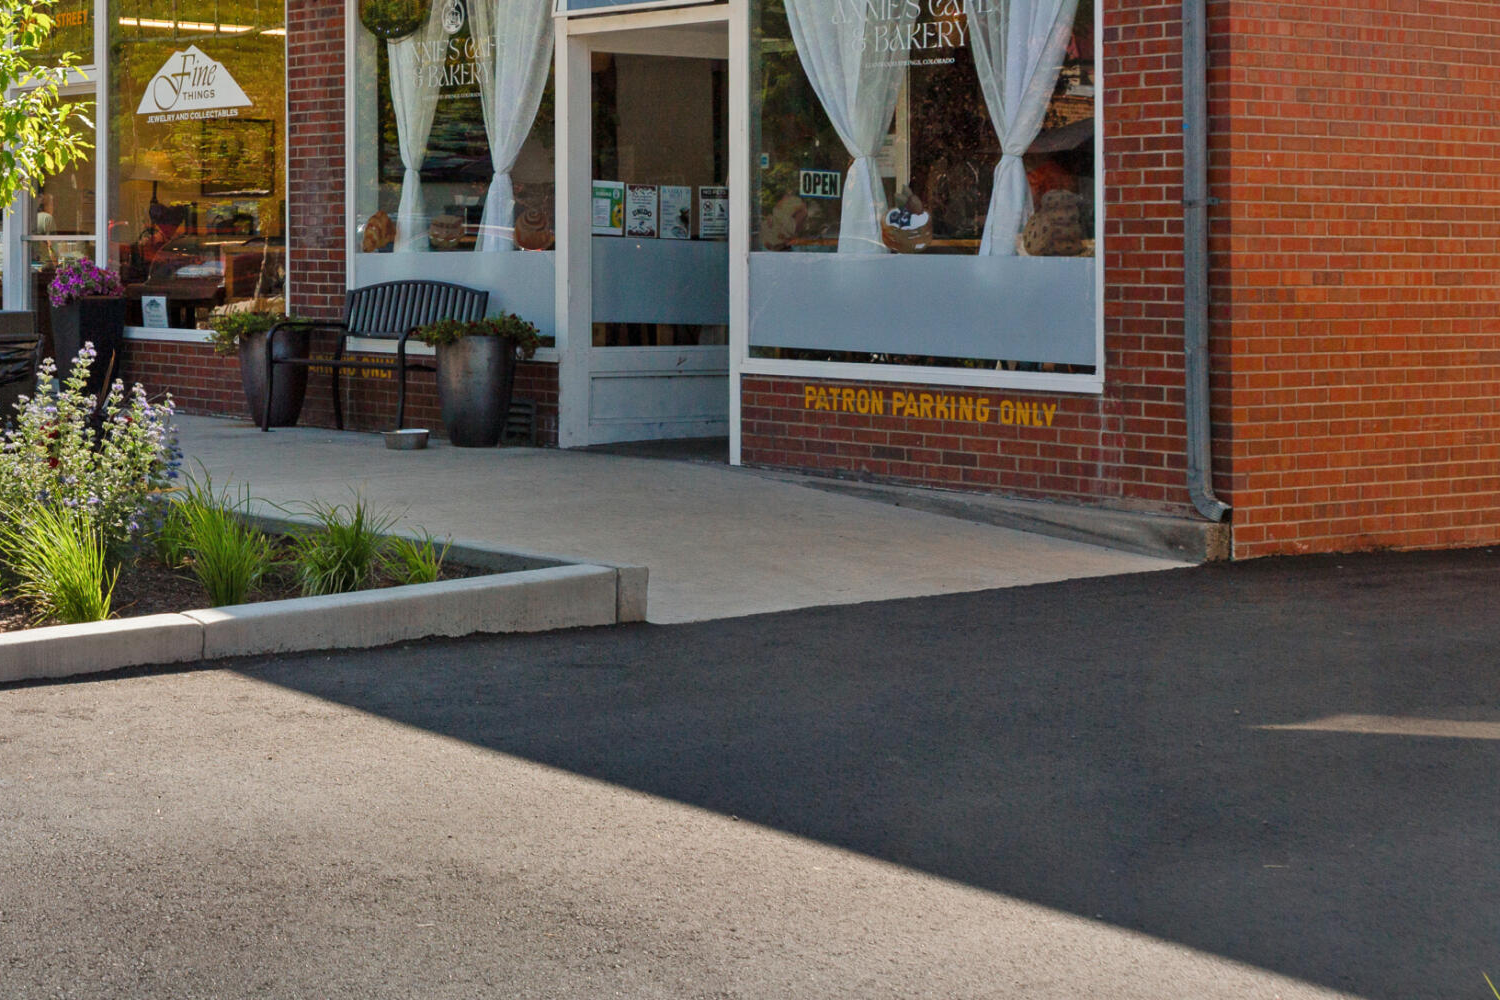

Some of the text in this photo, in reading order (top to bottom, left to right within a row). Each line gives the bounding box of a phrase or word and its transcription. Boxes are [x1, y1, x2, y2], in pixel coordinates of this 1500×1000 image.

[55, 9, 89, 28] STREET
[875, 21, 970, 52] BAKERY
[403, 39, 461, 64] NNIE'S
[153, 54, 217, 110] Fine
[428, 61, 492, 88] BAKERY
[182, 89, 215, 99] THINGS
[148, 108, 238, 123] JEWELRY AND COLLECTABLES
[803, 173, 838, 195] OPEN
[804, 386, 1057, 427] PATRON PARKING ONLY
